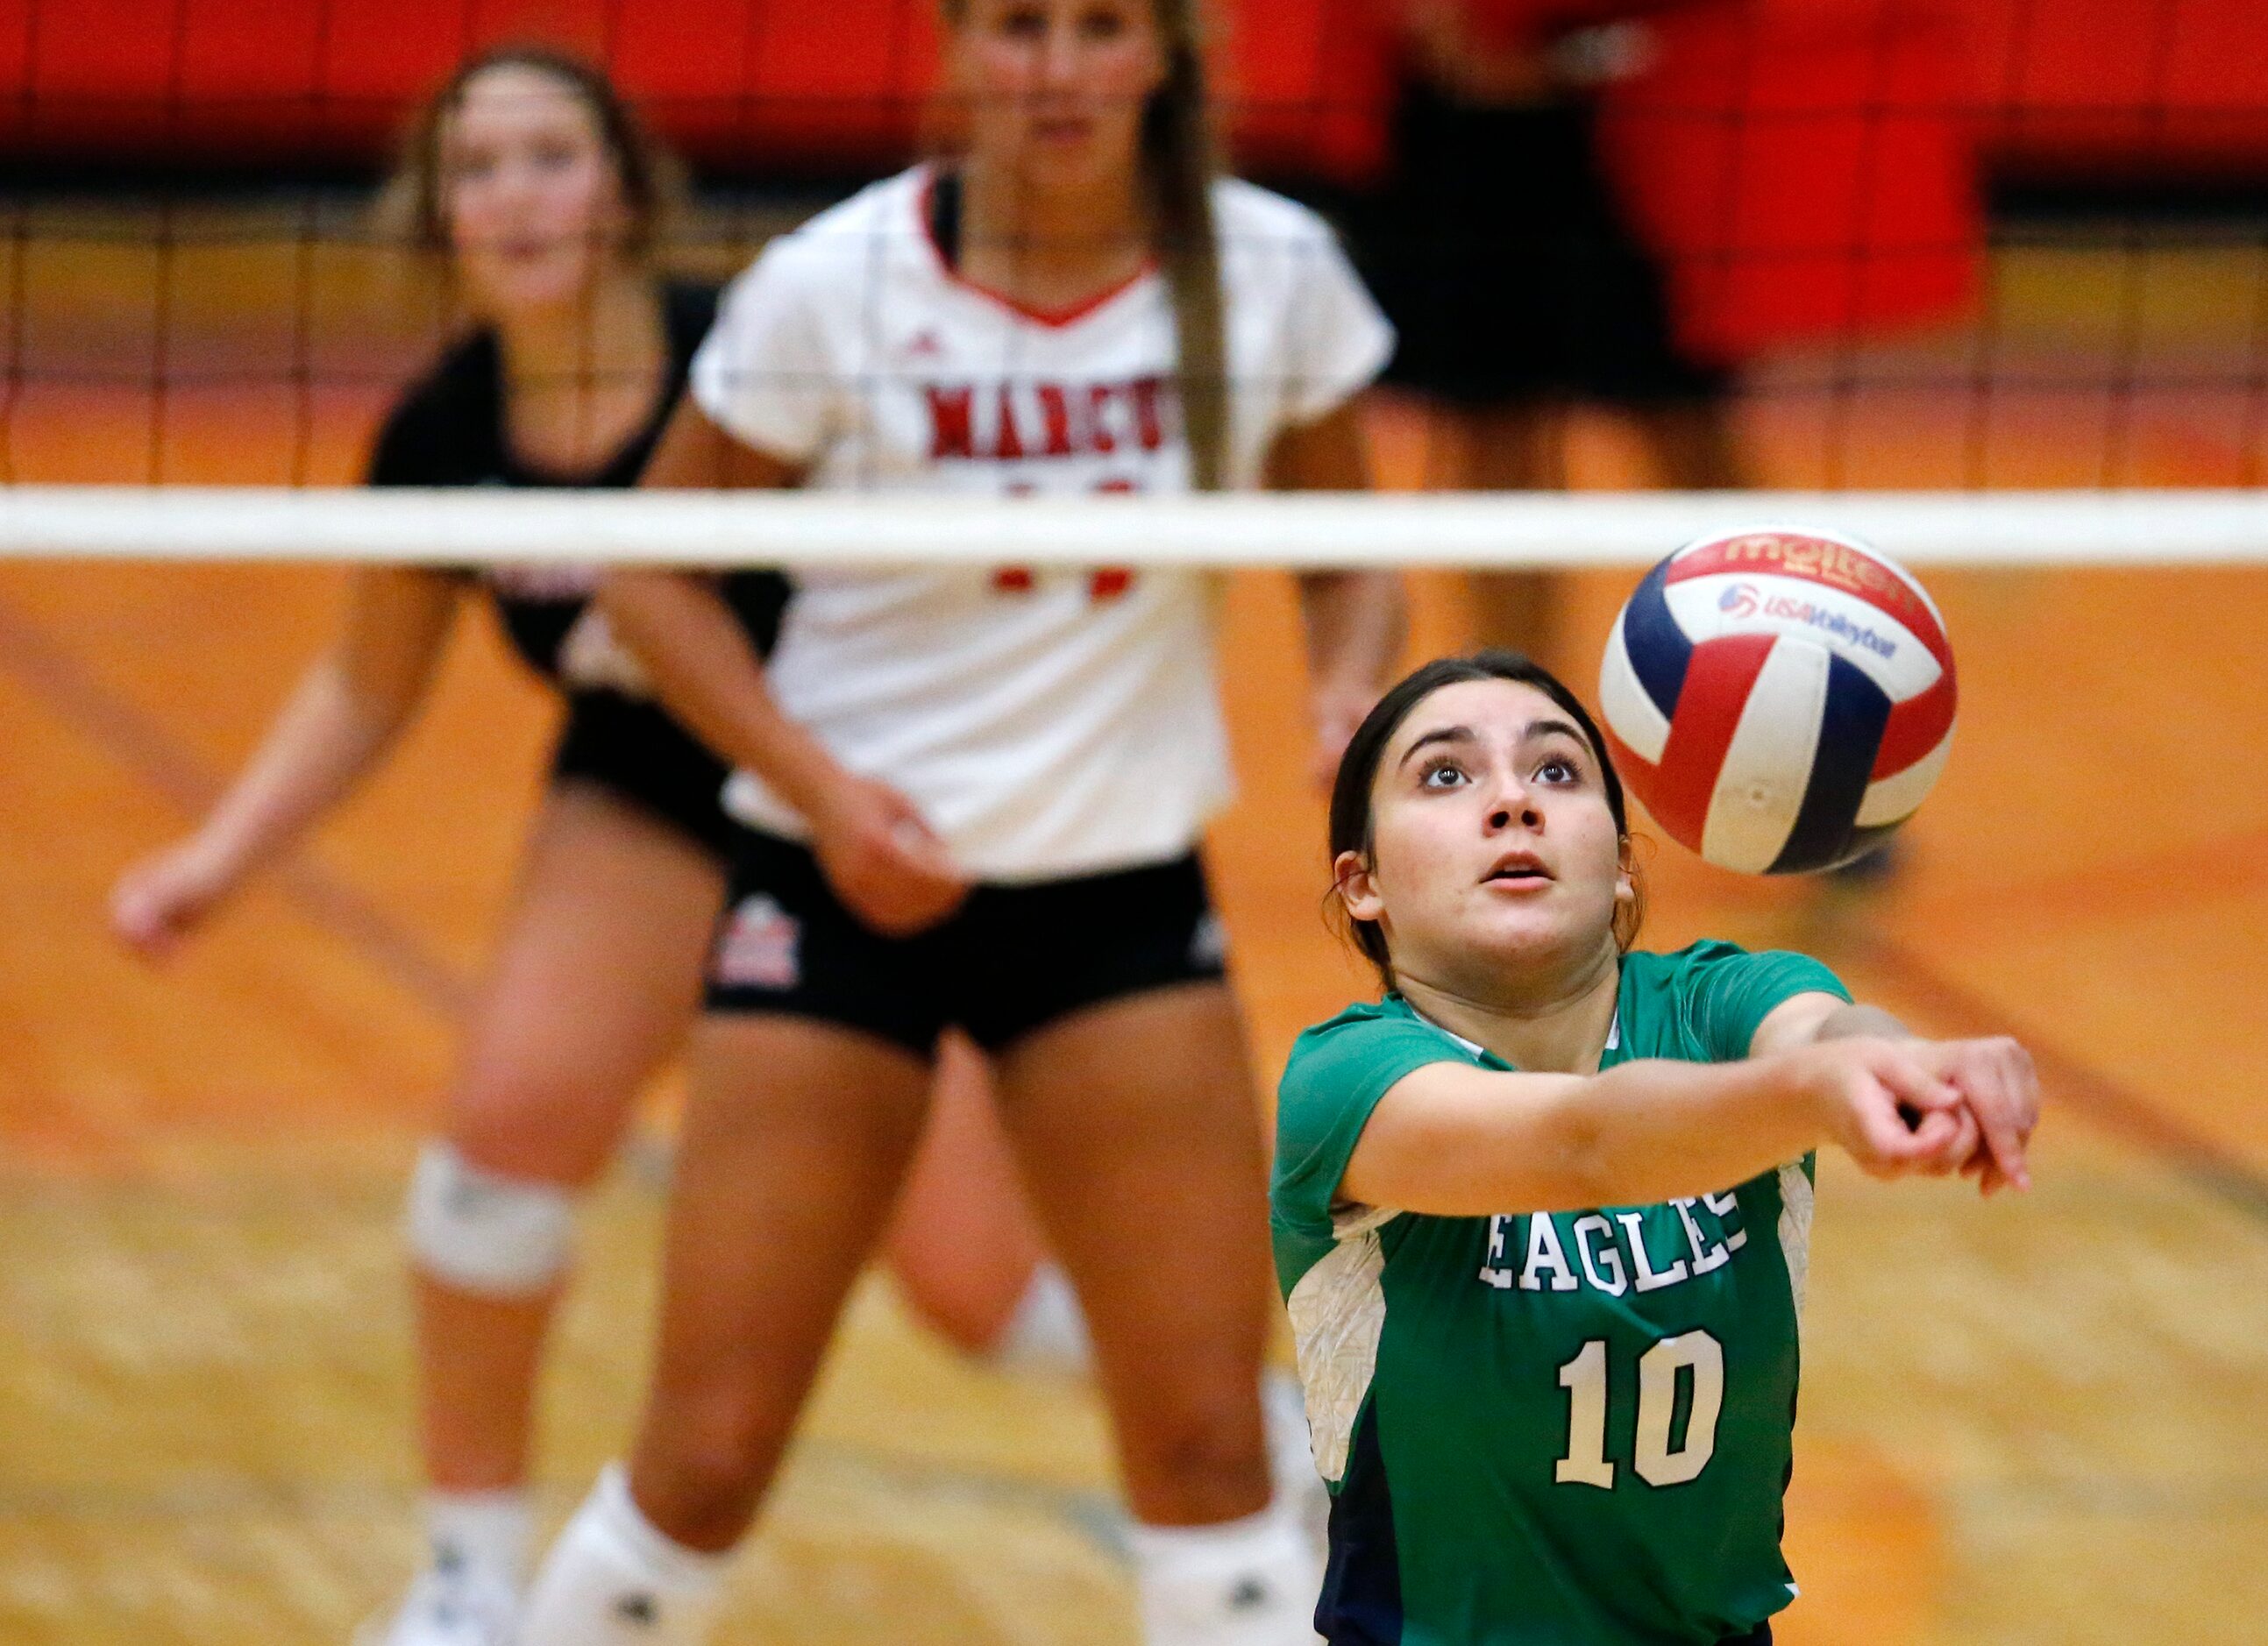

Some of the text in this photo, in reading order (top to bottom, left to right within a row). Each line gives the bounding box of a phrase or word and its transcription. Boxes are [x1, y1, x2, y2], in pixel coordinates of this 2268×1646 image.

[924, 375, 1180, 460] MARCU
[1724, 536, 1916, 613] molten
[1478, 1191, 1749, 1297] EAGLES
[1553, 1329, 1724, 1490] 10
